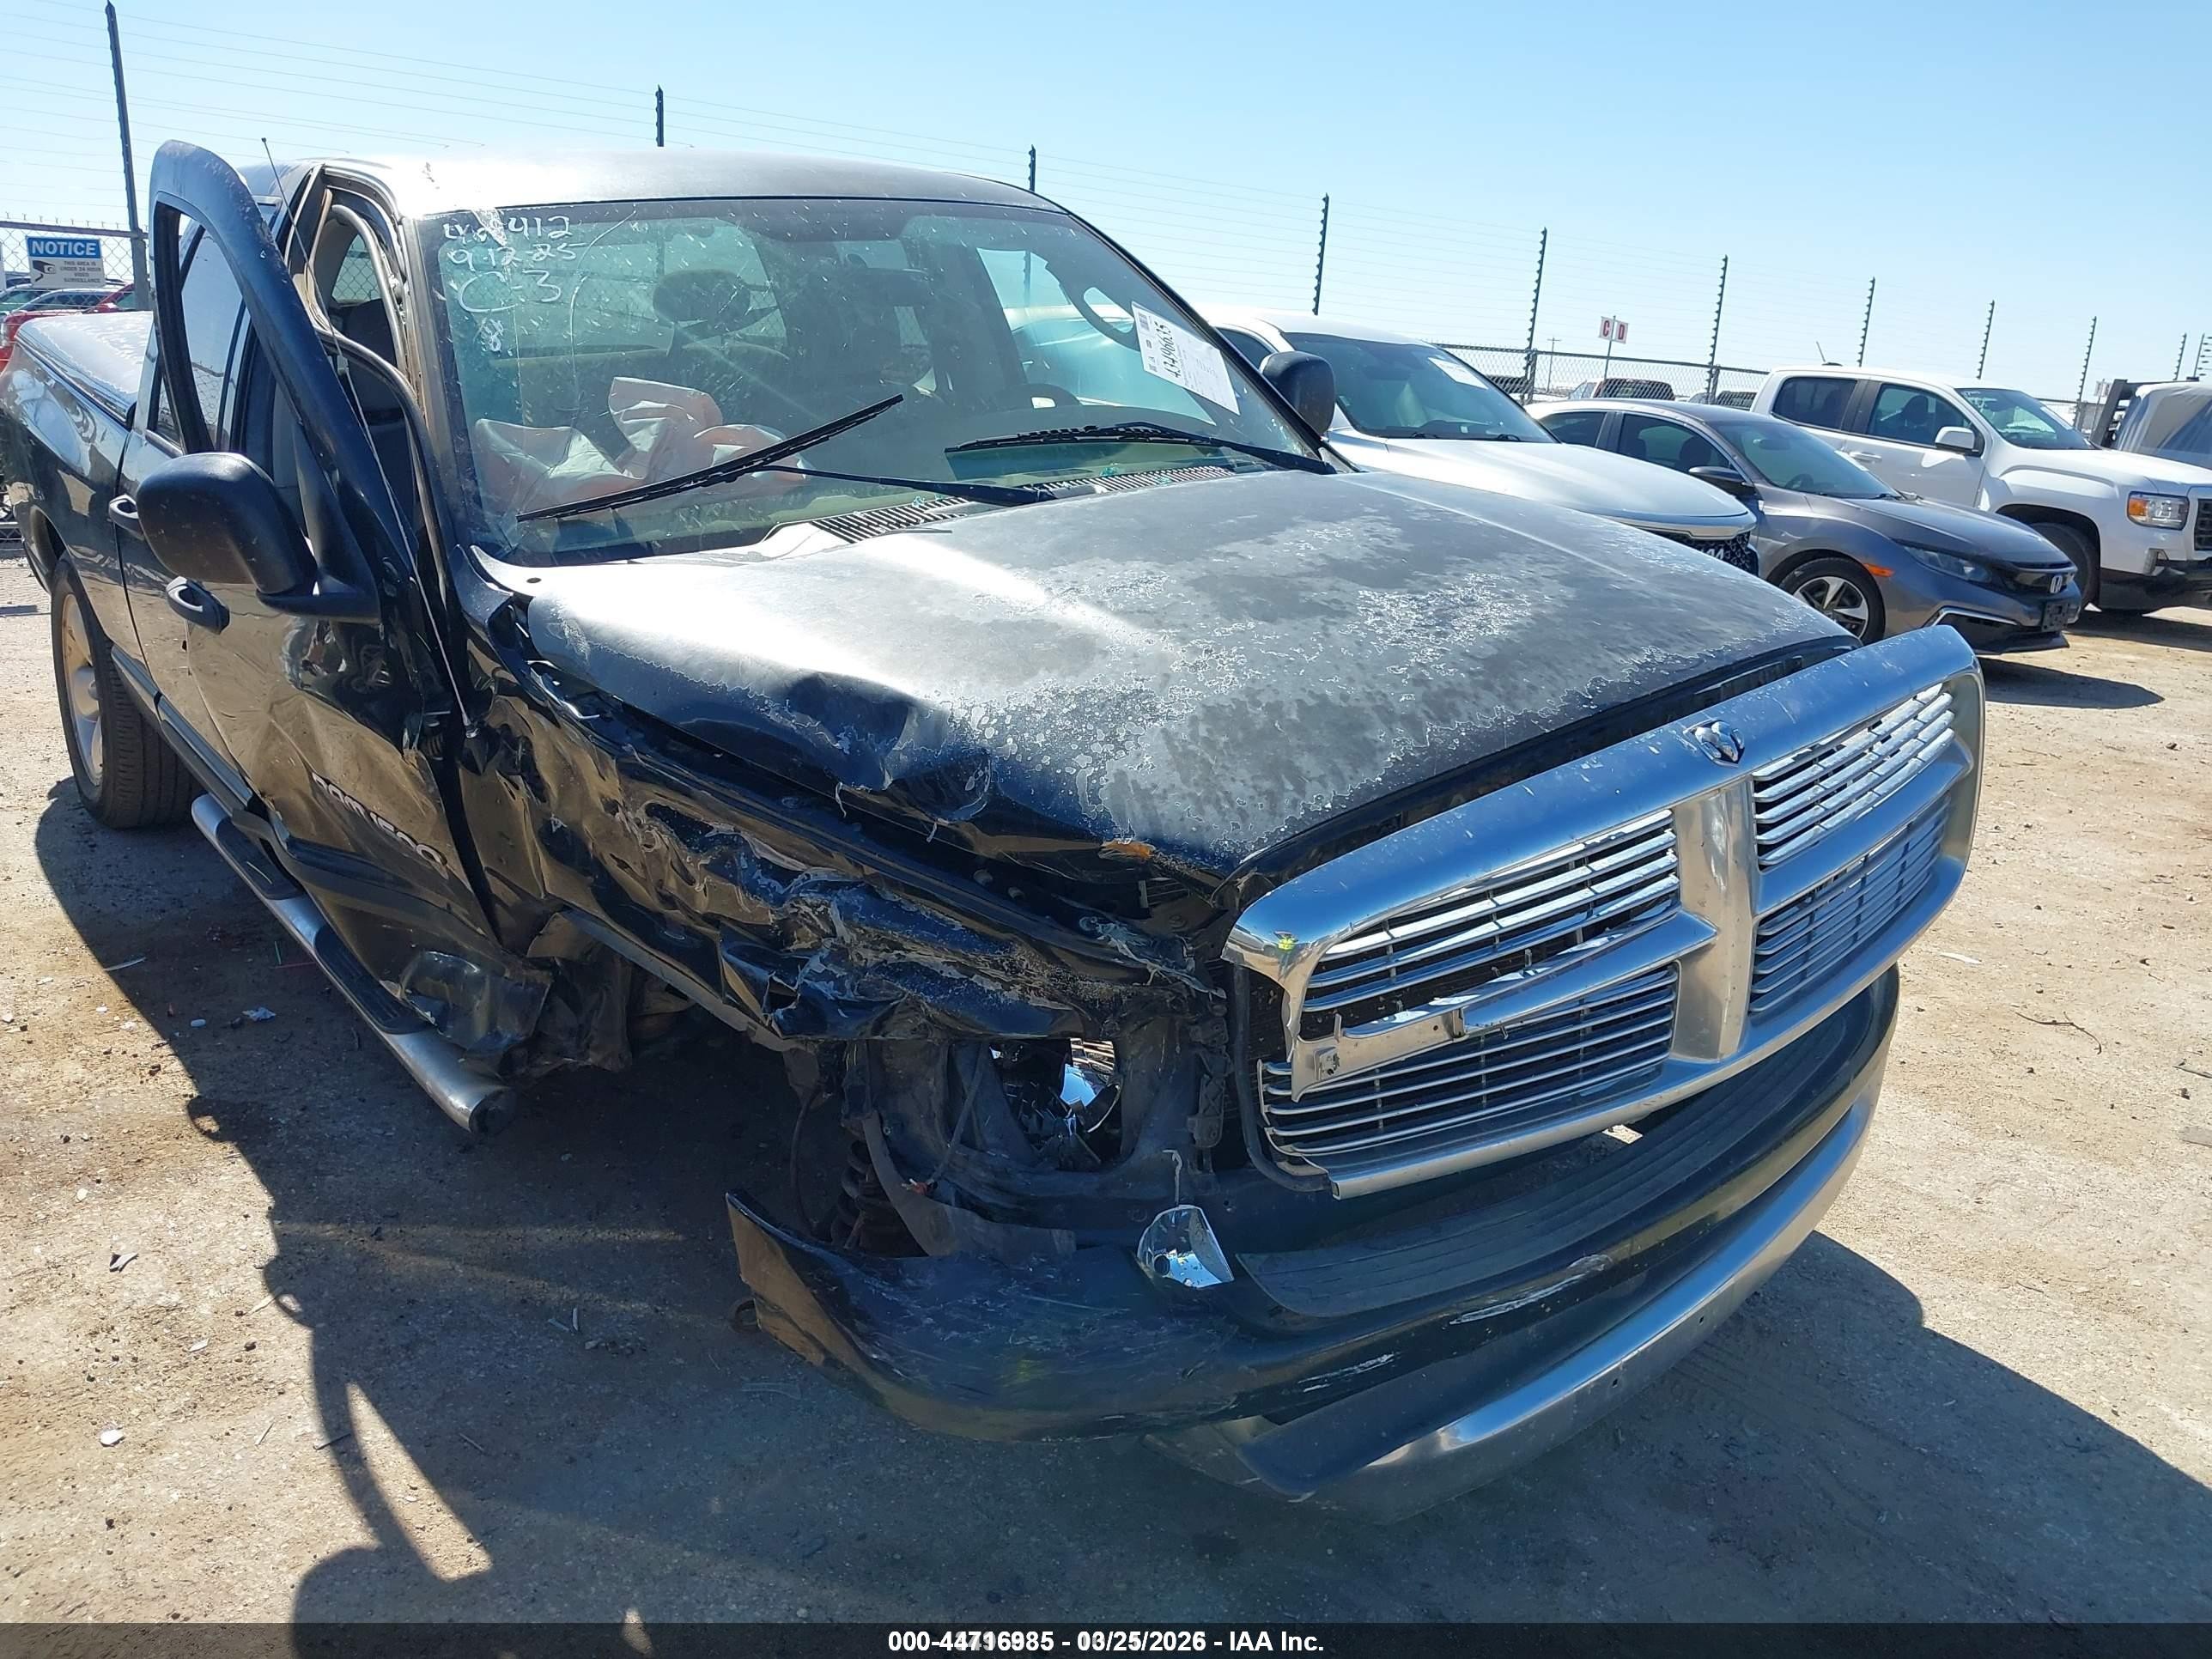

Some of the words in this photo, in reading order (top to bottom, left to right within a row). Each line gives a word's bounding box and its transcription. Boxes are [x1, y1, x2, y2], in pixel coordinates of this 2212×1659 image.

[32, 240, 96, 255] NOTICE
[1602, 320, 1610, 337] C
[1618, 324, 1626, 340] D
